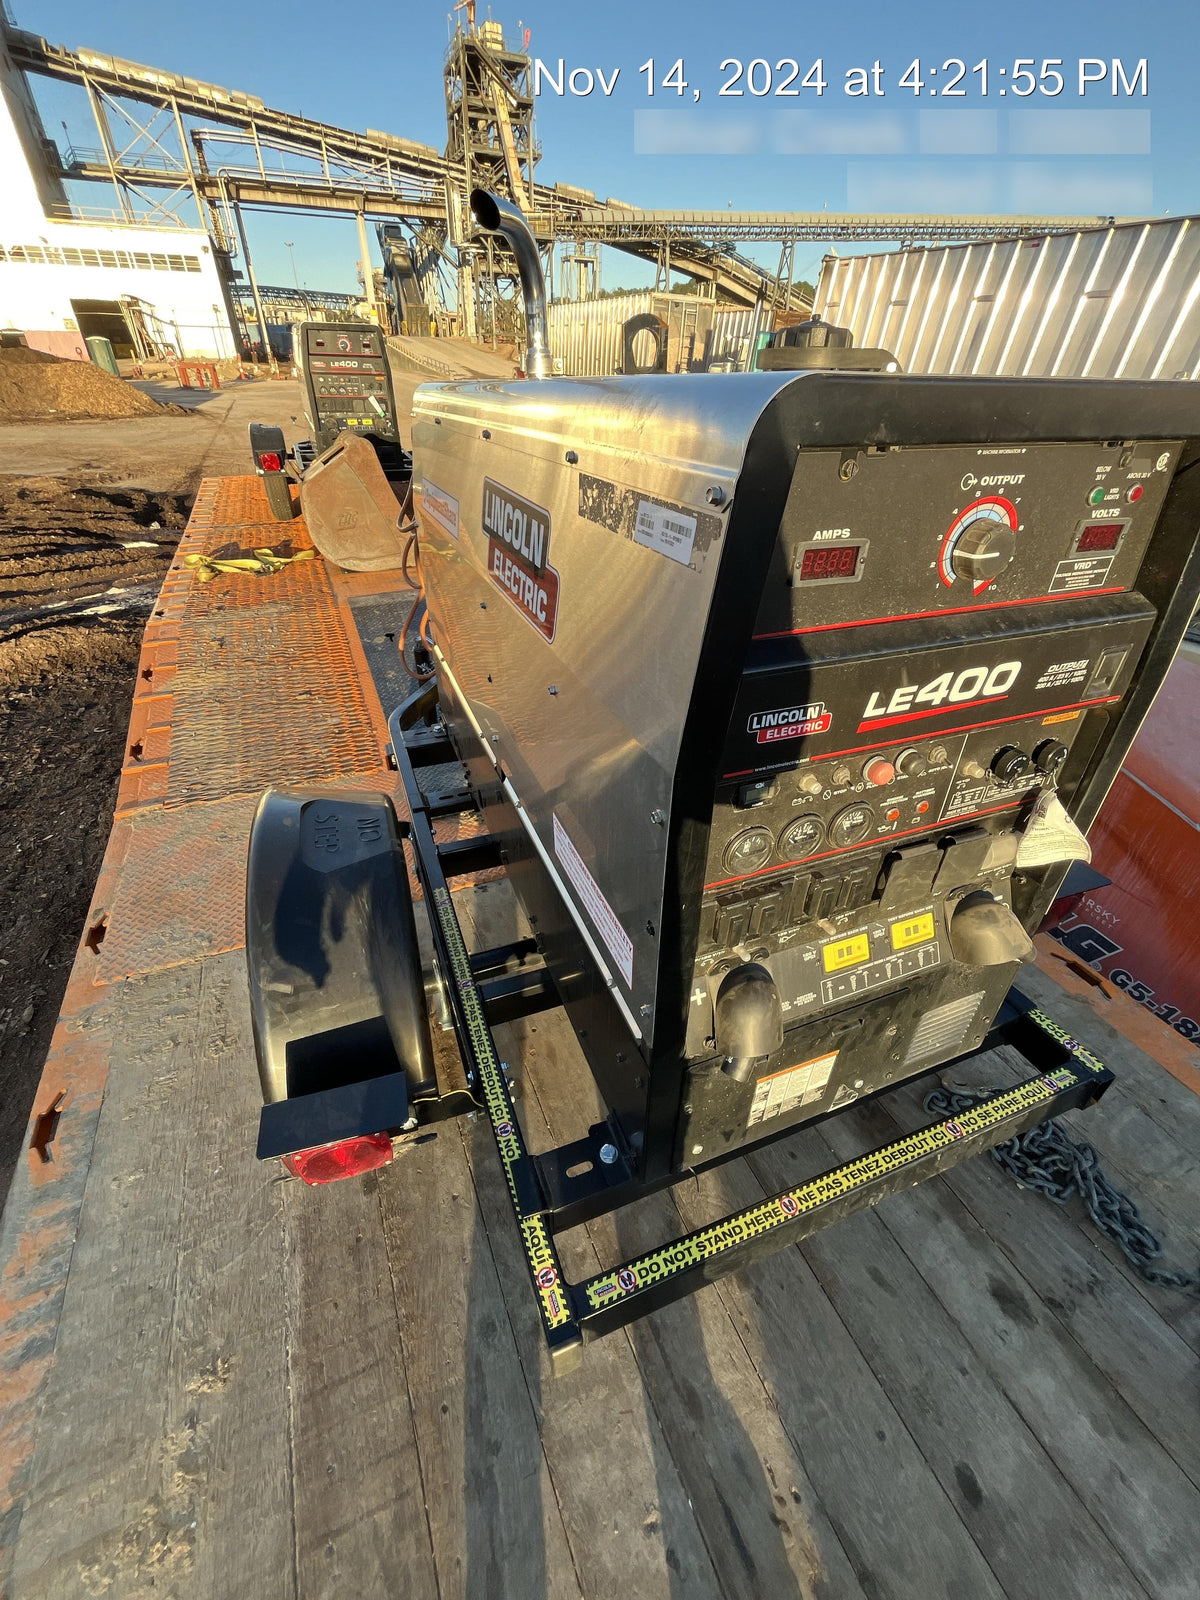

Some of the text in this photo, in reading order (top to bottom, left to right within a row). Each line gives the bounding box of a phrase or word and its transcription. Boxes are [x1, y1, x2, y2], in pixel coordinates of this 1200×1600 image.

[980, 474, 1026, 486] OUTPUT
[998, 487, 1004, 495] 6
[1091, 508, 1120, 519] VOLTS
[484, 489, 545, 568] LINCOLN
[812, 528, 851, 541] AMPS
[929, 561, 936, 569] 2
[493, 547, 548, 623] ELECTRIC
[1047, 659, 1089, 673] OUTPUT
[862, 661, 1022, 719] LE400
[752, 705, 820, 729] LINCOLN
[766, 720, 824, 740] ELECTRIC
[833, 788, 848, 796] STOP
[313, 813, 342, 853] STEP
[355, 816, 384, 843] NO
[442, 906, 468, 980] DO NOT STAND HERE
[1108, 968, 1200, 1047] G5-18
[464, 990, 505, 1120] NE PAS TENEZ DEBOUT ICI
[959, 1119, 977, 1130] NO
[977, 1111, 990, 1125] SE
[994, 1098, 1021, 1117] PARE
[503, 1137, 516, 1159] NO
[797, 1131, 948, 1206] NE PAS TENEZ DEBOUT ICI
[638, 1206, 783, 1279] DO NOT STAND HERE
